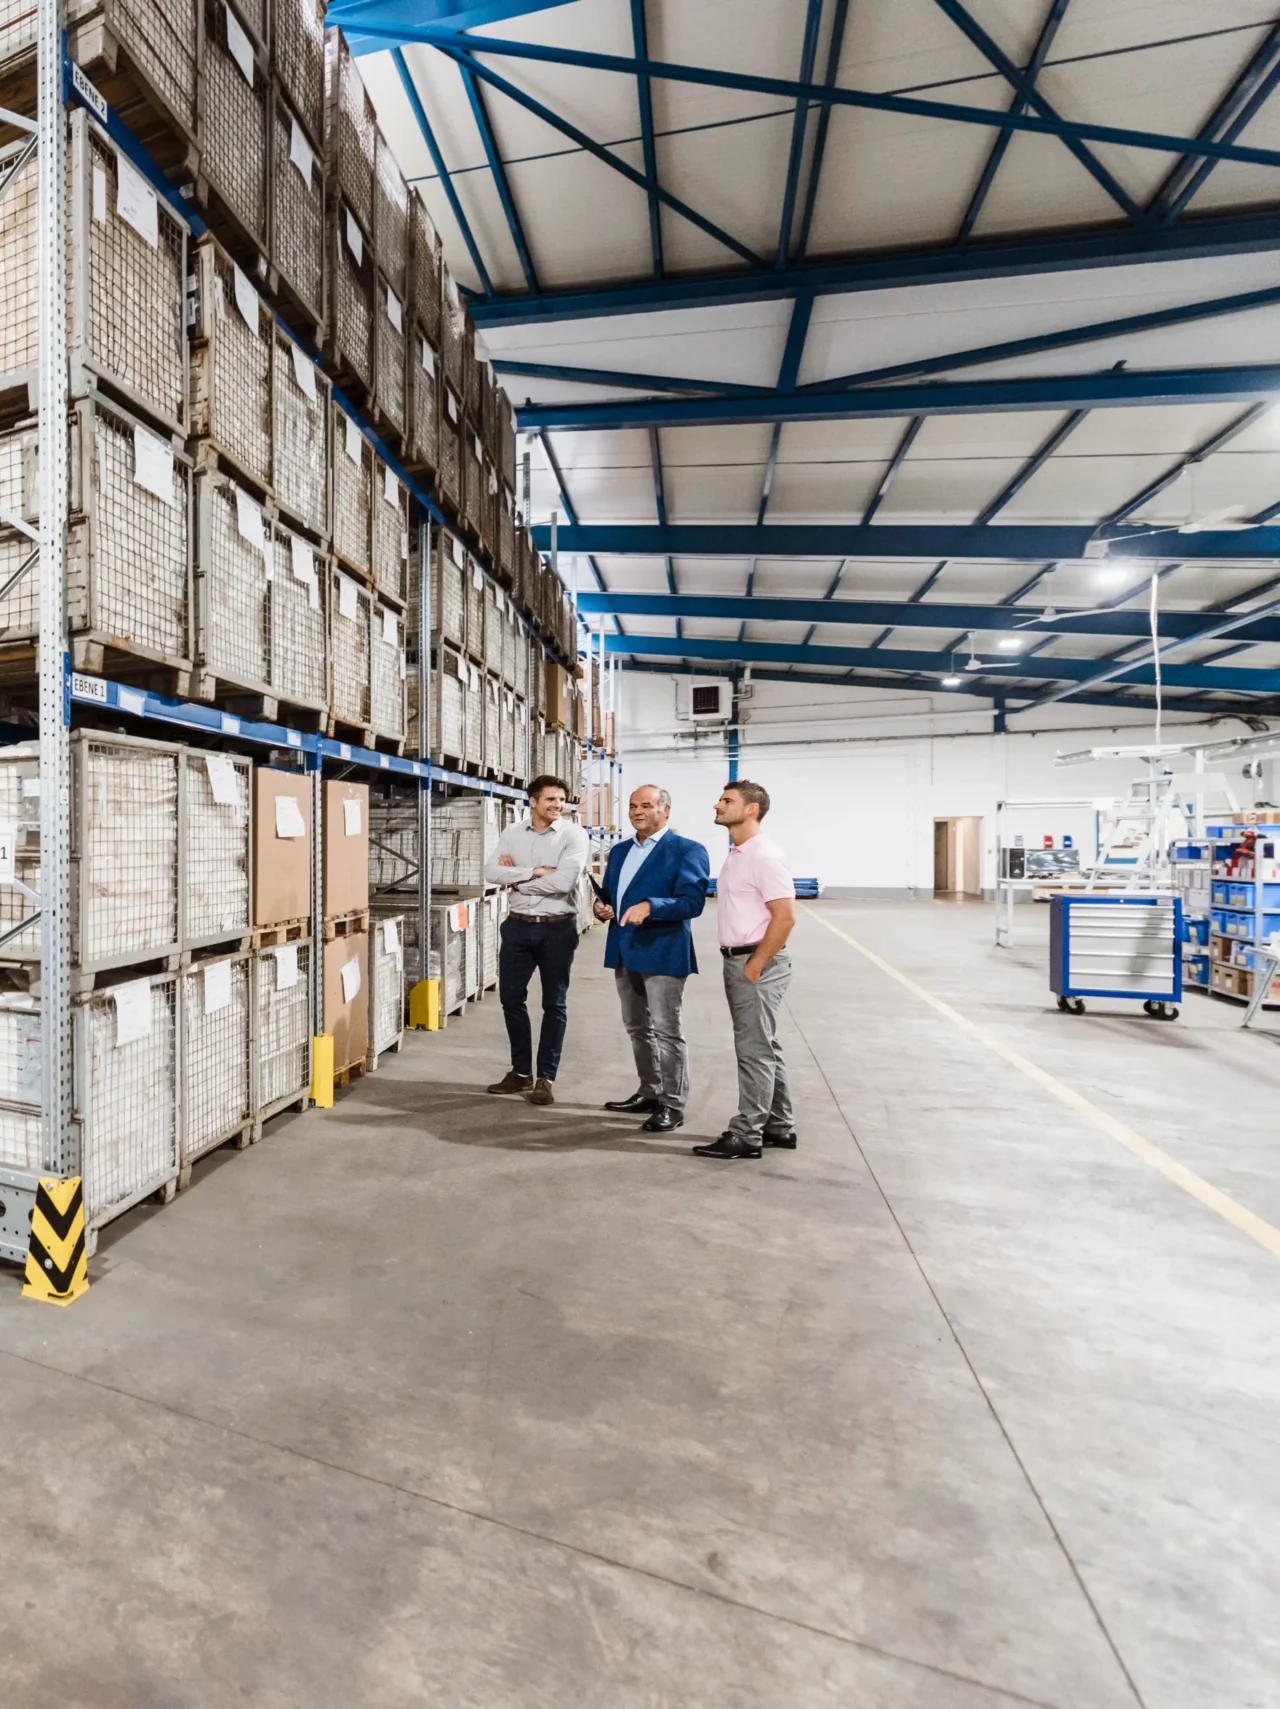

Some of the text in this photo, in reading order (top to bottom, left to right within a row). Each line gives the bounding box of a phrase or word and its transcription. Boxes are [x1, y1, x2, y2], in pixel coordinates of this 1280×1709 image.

[75, 70, 100, 110] EBENE
[74, 678, 99, 696] EBENE
[0, 846, 8, 860] 1
